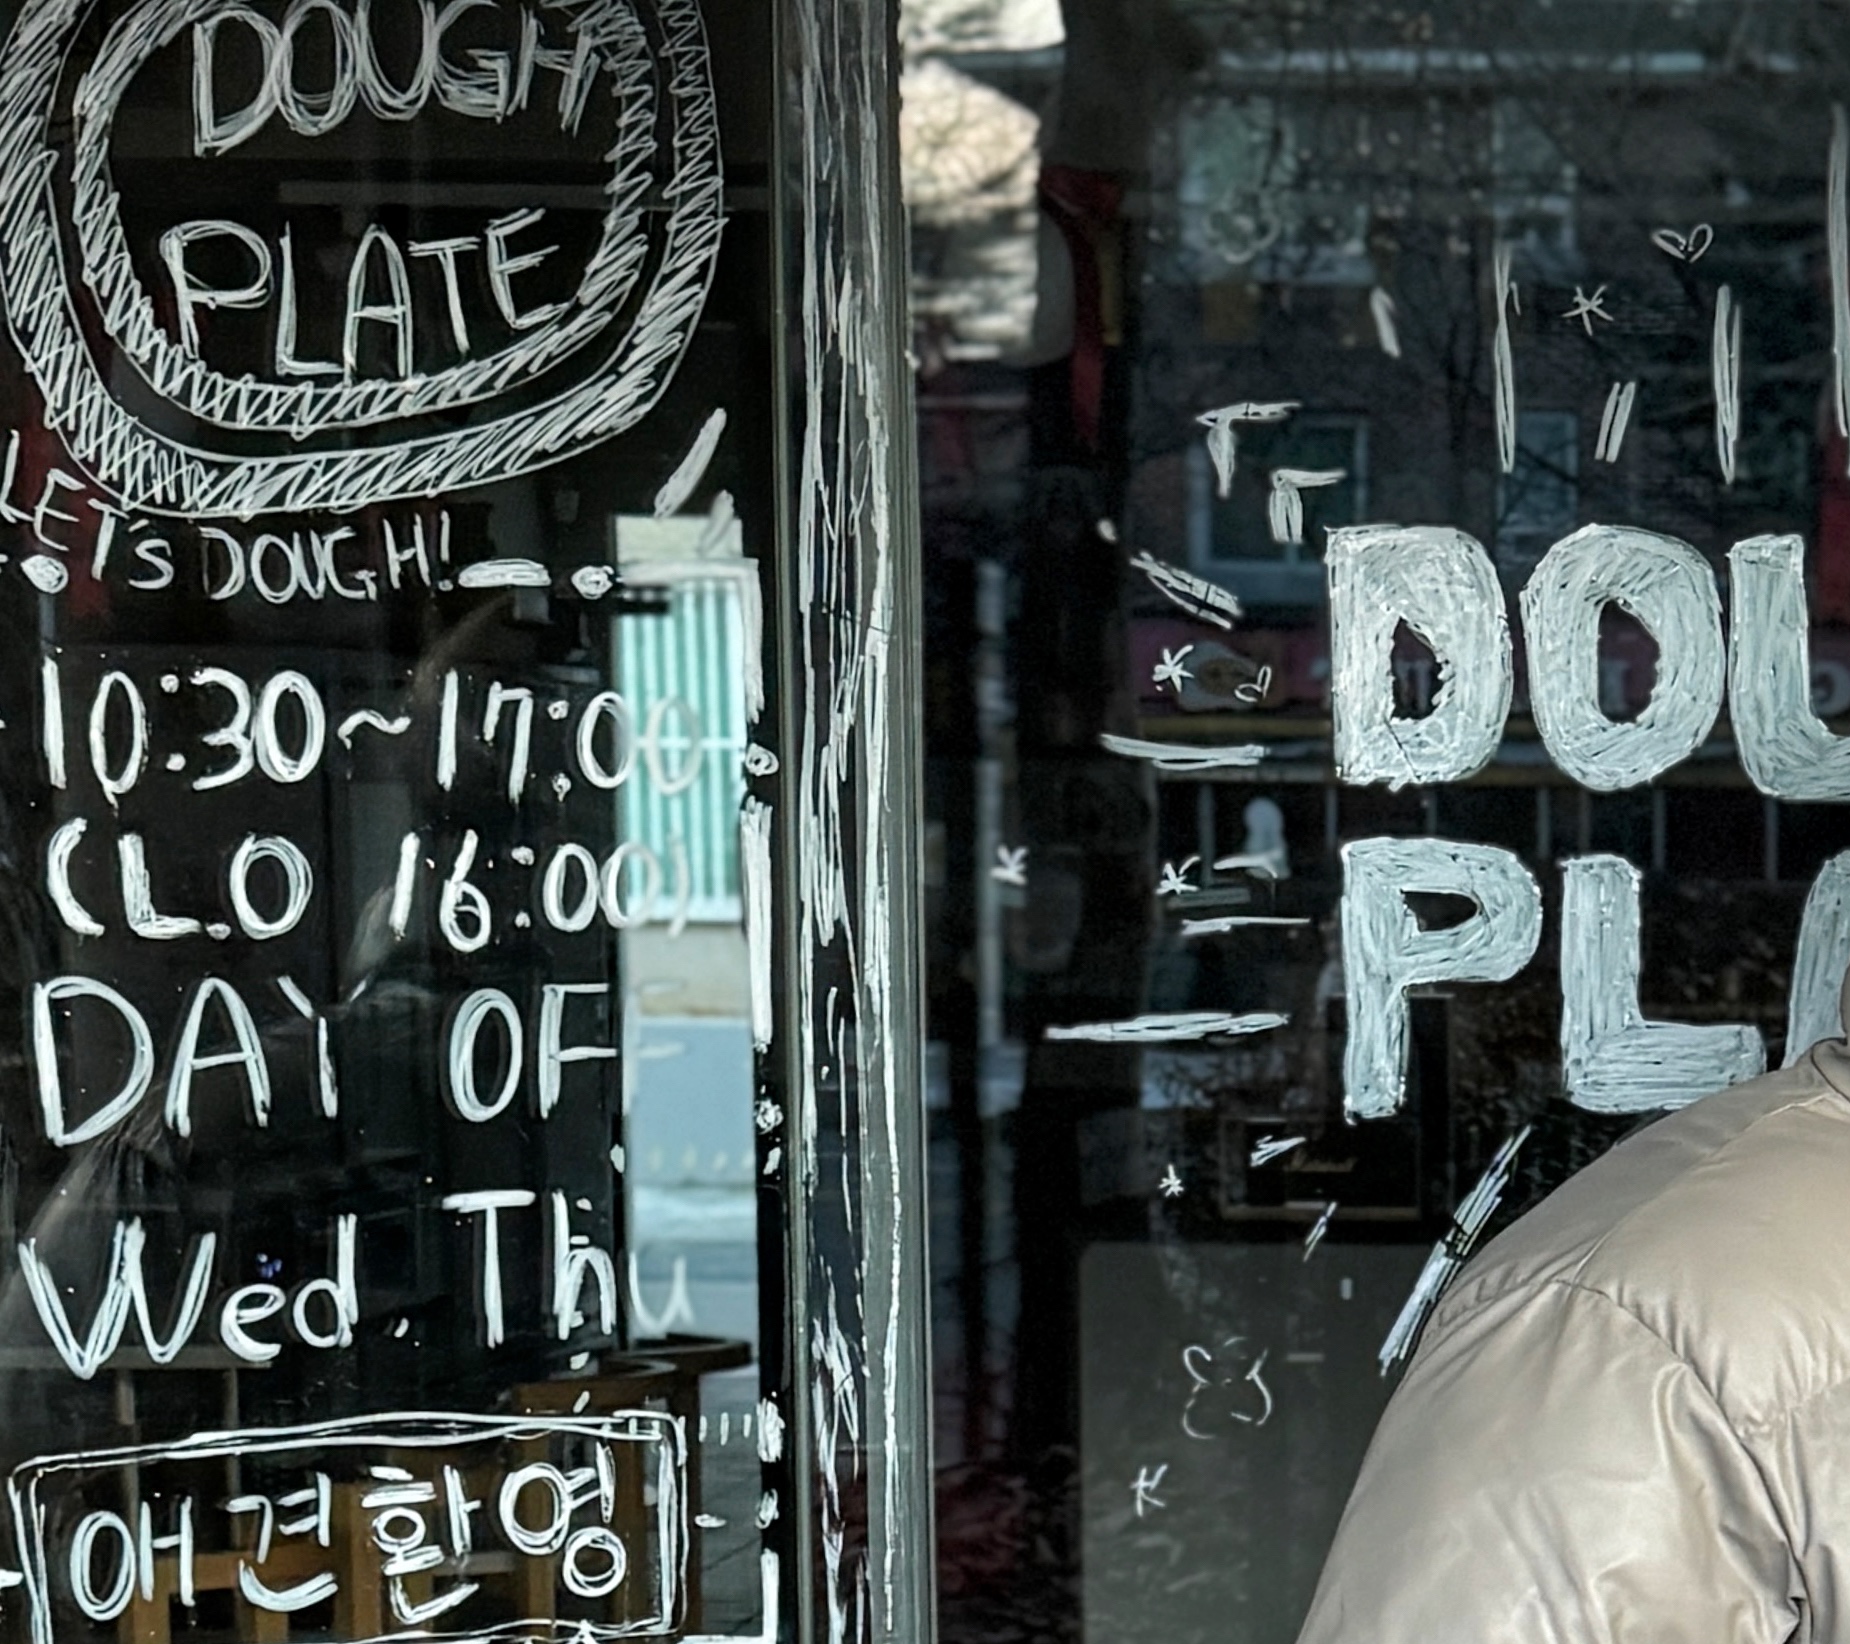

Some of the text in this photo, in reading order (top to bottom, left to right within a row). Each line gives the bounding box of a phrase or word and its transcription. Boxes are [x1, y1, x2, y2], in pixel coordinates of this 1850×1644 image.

[193, 0, 603, 155] DOUGH
[160, 209, 565, 384] PLATE
[198, 510, 454, 604] DOUGH!
[34, 976, 338, 1146] DAY
[443, 1189, 695, 1348] Thu
